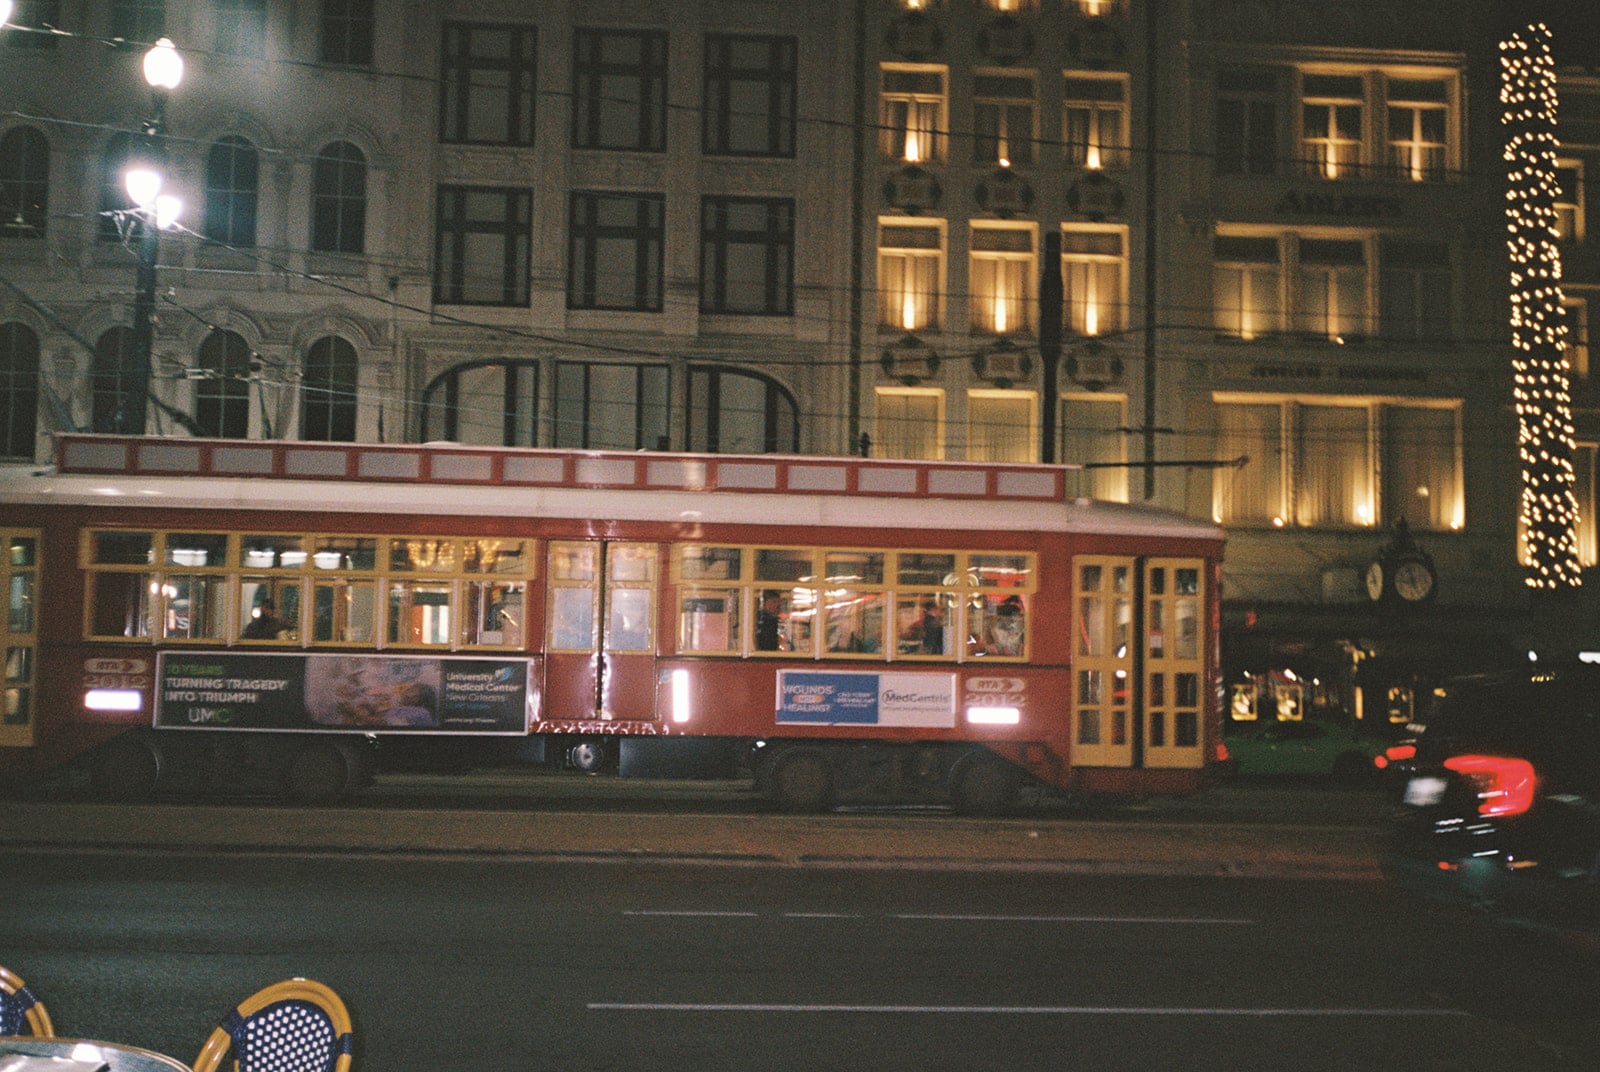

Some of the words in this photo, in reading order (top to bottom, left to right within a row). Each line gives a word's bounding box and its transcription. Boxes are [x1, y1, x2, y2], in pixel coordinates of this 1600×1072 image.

[446, 672, 494, 682] University
[165, 677, 224, 689] TURNING
[226, 679, 289, 690] TRAGEDY
[446, 683, 484, 691] Medical
[486, 684, 521, 692] Center
[977, 681, 1000, 690] RTA
[783, 685, 833, 695] WOUNDS
[164, 691, 197, 702] INTO
[199, 692, 258, 703] TRIUMPH
[469, 693, 507, 702] Orleans
[965, 693, 1026, 707] 2012
[783, 704, 831, 713] HEALING?
[188, 707, 232, 723] UMC
